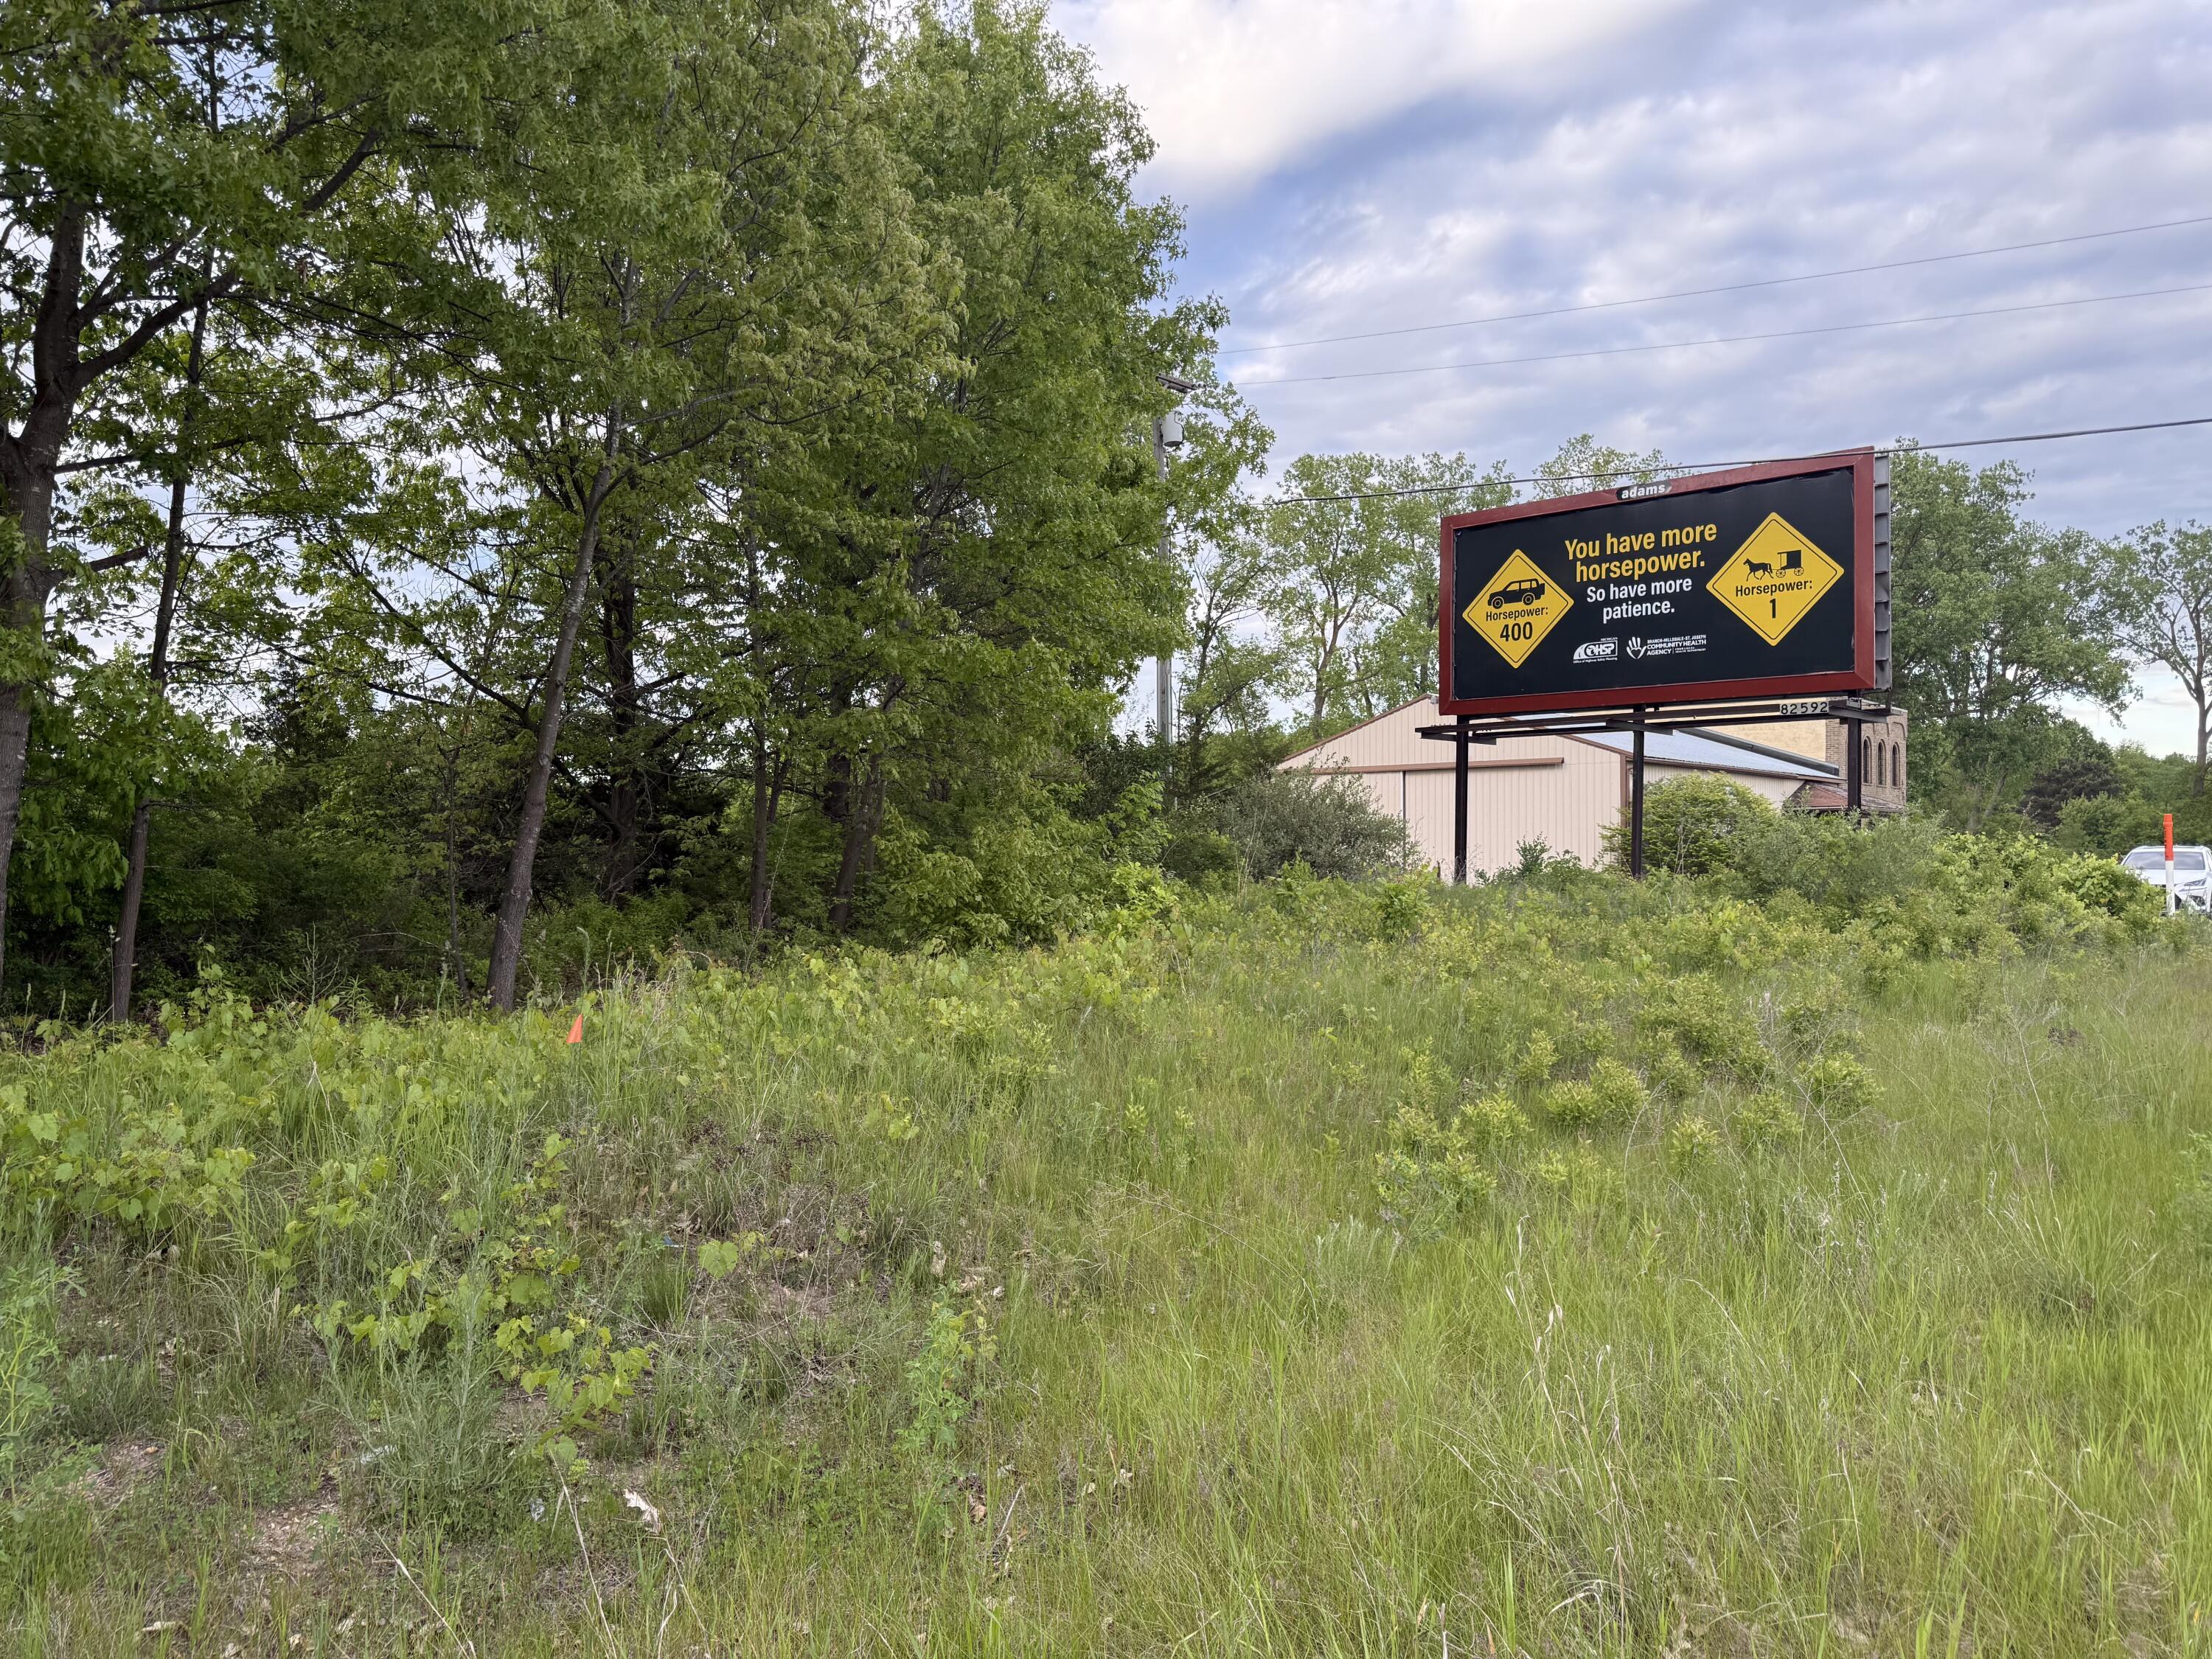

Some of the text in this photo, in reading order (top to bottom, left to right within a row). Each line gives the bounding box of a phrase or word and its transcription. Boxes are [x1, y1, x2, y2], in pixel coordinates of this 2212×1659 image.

[1621, 484, 1665, 498] adams
[1565, 524, 1717, 560] You have more
[1576, 550, 1705, 582] horsepower.
[1587, 578, 1692, 602] So have more
[1736, 580, 1812, 597] Horsepower:
[1486, 607, 1548, 622] Horsepower:
[1603, 600, 1675, 624] patience.
[1770, 599, 1776, 619] 1
[1500, 622, 1533, 642] 400
[1586, 643, 1615, 656] OHSP
[1647, 641, 1683, 650] COMMUNITY
[1781, 702, 1828, 714] 82592
